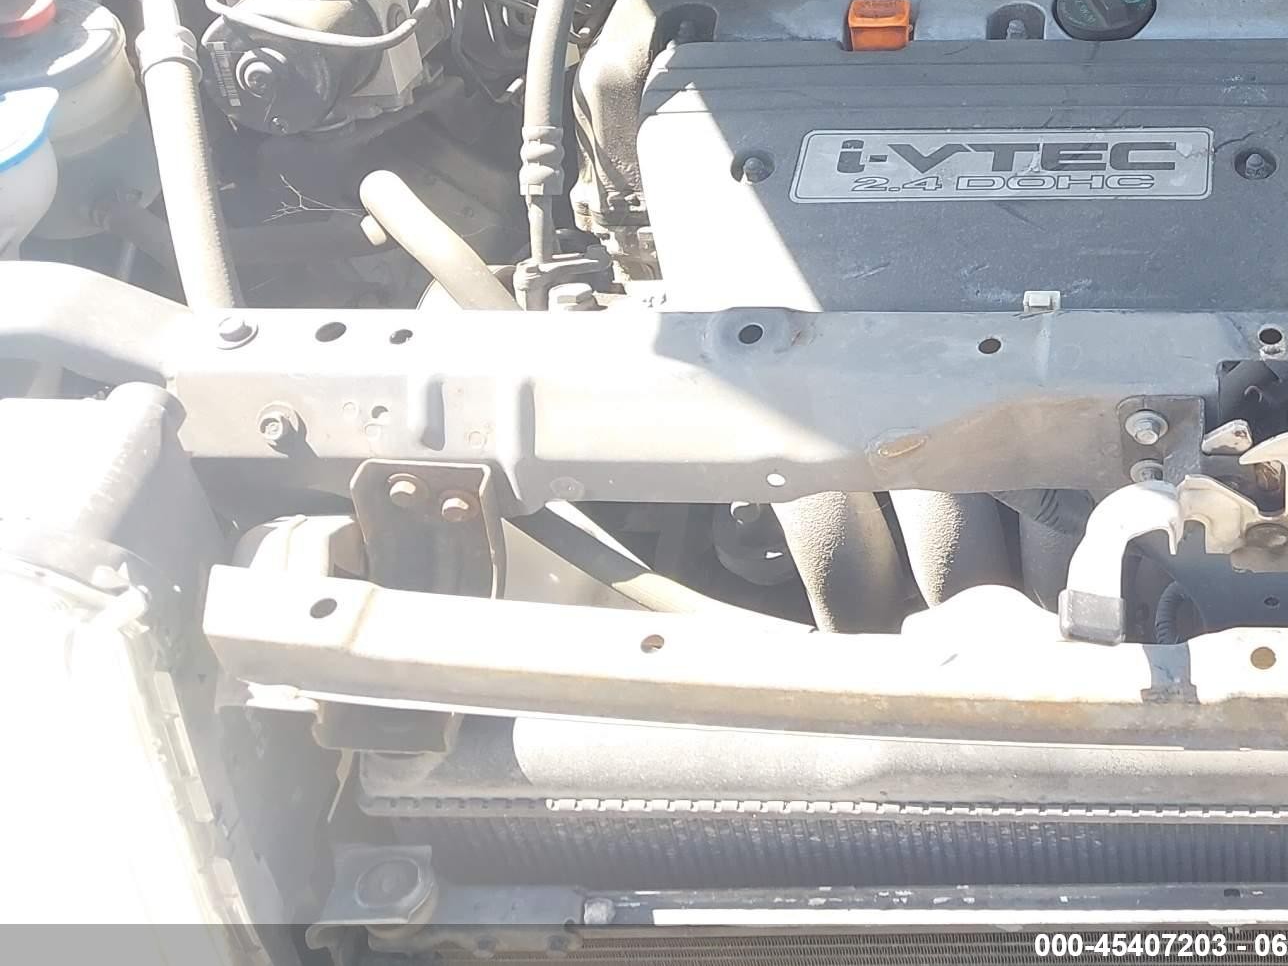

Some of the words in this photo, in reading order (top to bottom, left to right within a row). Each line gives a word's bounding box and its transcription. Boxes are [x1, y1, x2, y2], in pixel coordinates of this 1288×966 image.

[836, 139, 1177, 173] i-VTEC
[851, 175, 943, 192] 2.4
[955, 174, 1156, 191] DOHC
